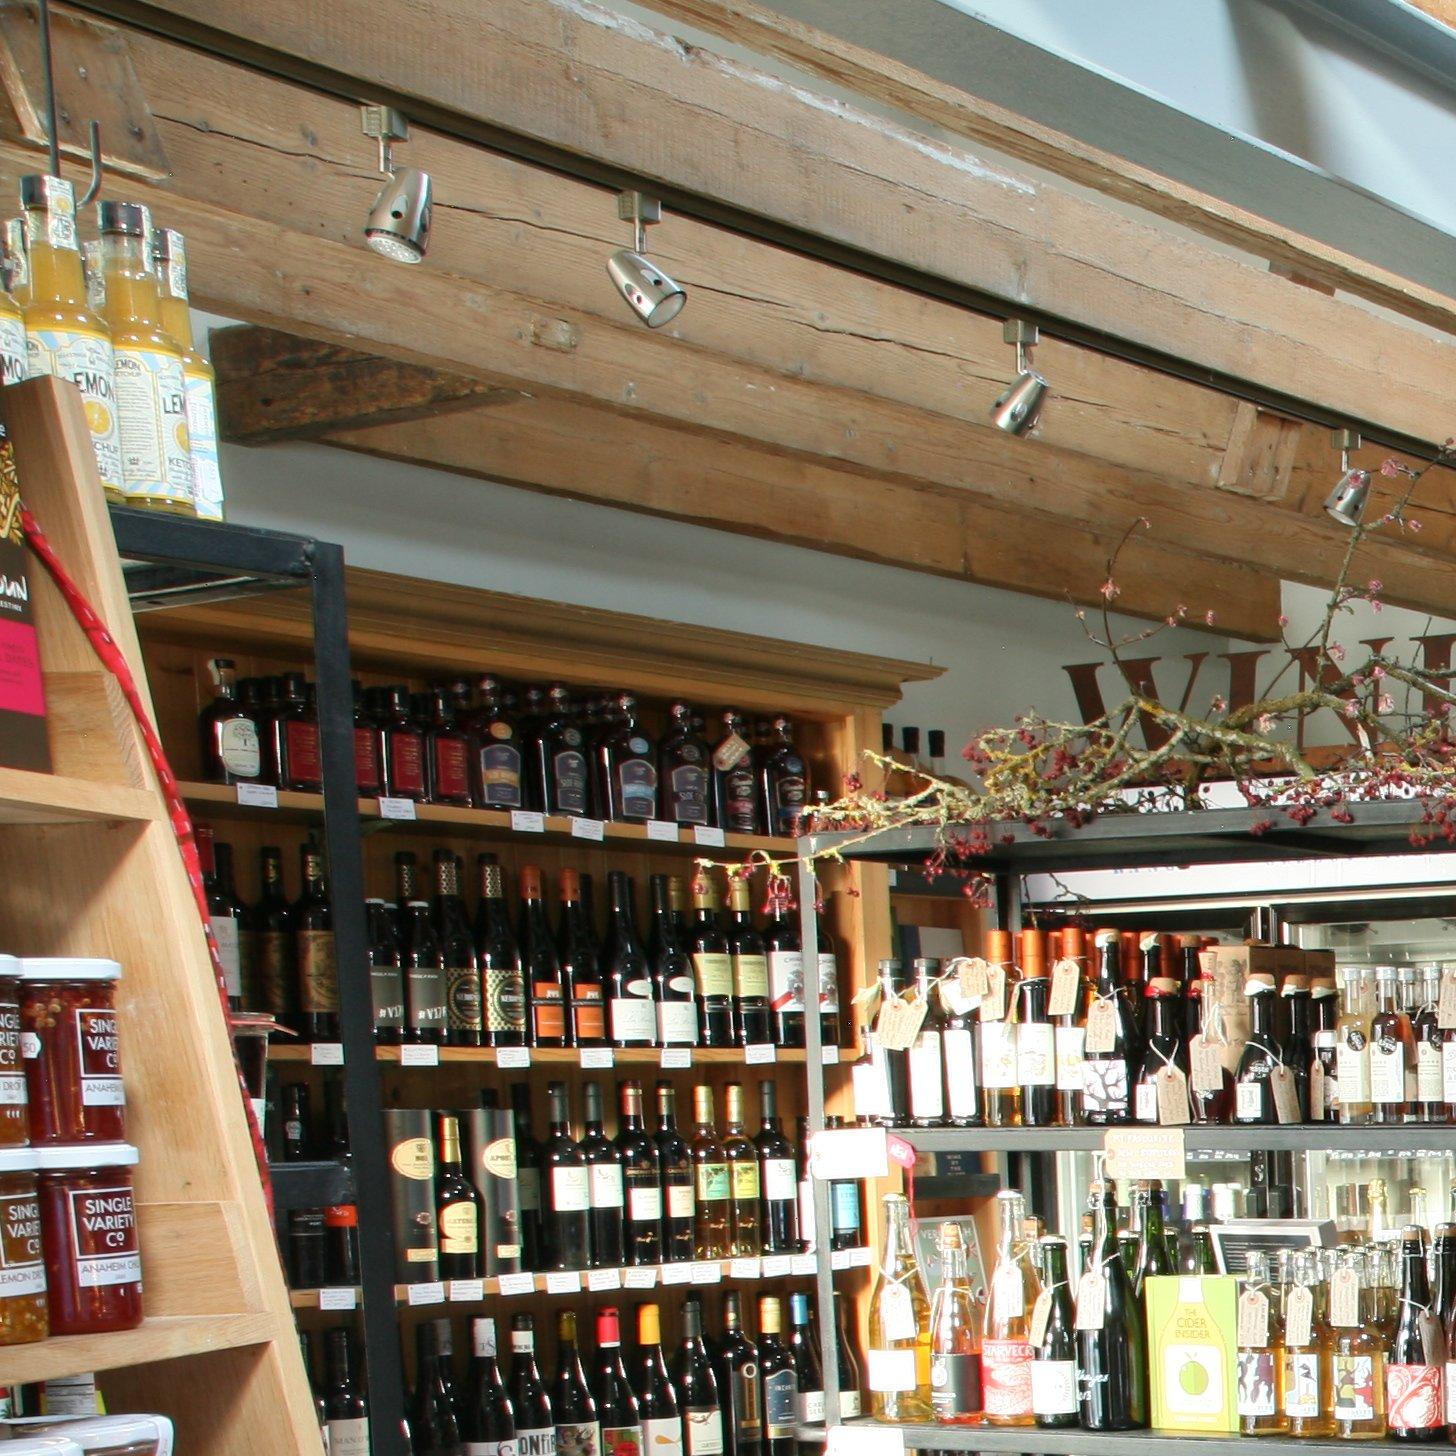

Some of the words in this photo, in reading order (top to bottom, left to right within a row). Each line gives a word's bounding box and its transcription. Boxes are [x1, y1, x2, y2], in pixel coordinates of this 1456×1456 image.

[85, 1197, 132, 1216] SINGLE
[82, 1214, 135, 1233] VARIETY
[1176, 1317, 1207, 1328] CIDER
[1175, 1328, 1210, 1339] INSIDER
